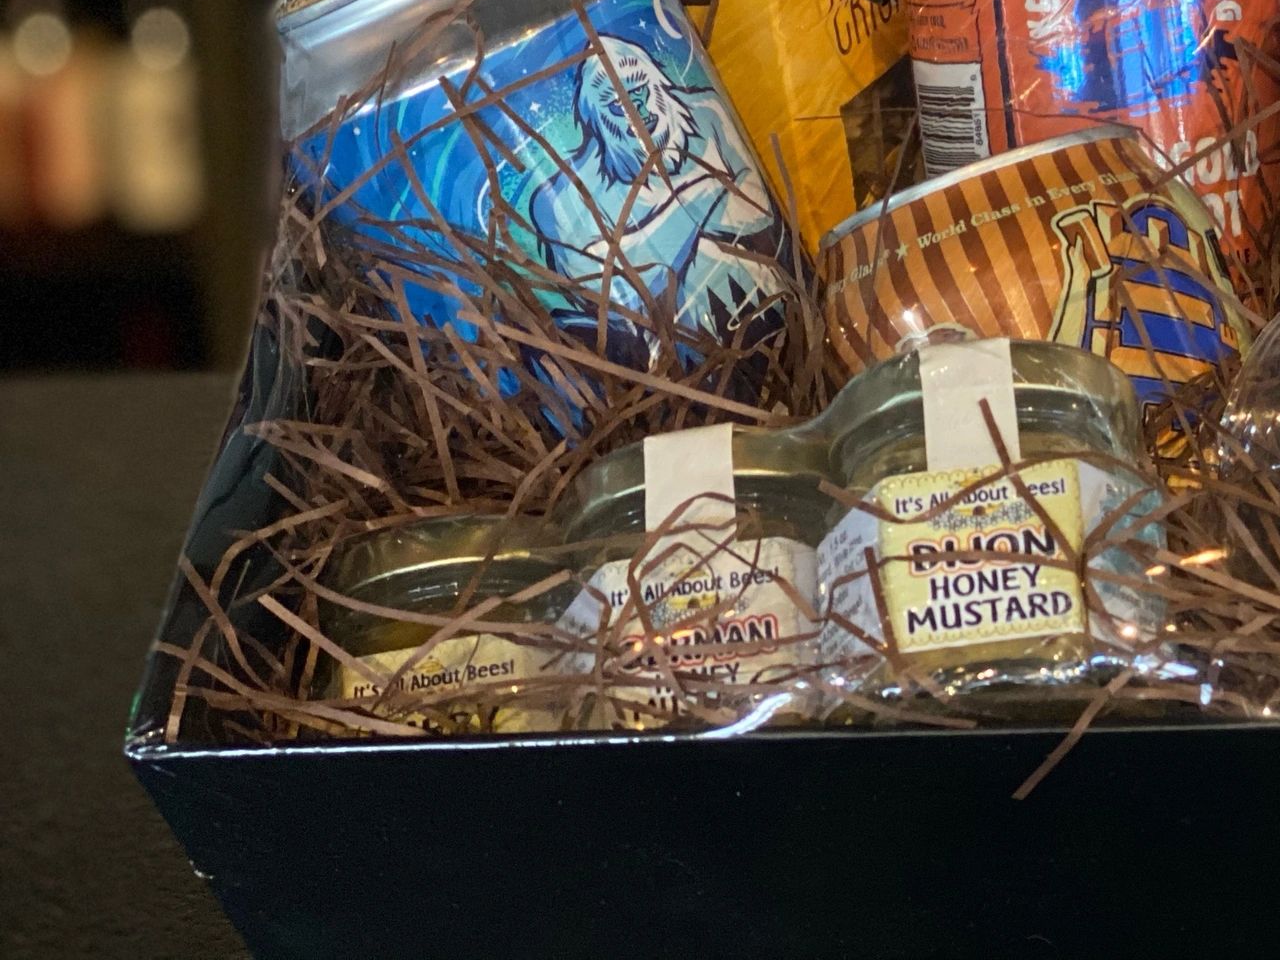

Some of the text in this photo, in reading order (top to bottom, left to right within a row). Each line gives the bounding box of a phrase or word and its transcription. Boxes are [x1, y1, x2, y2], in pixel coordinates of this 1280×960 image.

[915, 219, 968, 250] World
[970, 201, 1023, 228] Class
[1045, 178, 1098, 205] Every
[893, 493, 925, 516] It's
[1017, 477, 1067, 506] ees!
[907, 526, 1058, 573] DIJON
[644, 581, 666, 603] All
[928, 564, 1043, 602] HONEY
[906, 590, 1074, 635] MUSTARD
[410, 668, 460, 692] About
[467, 658, 516, 682] Bees!
